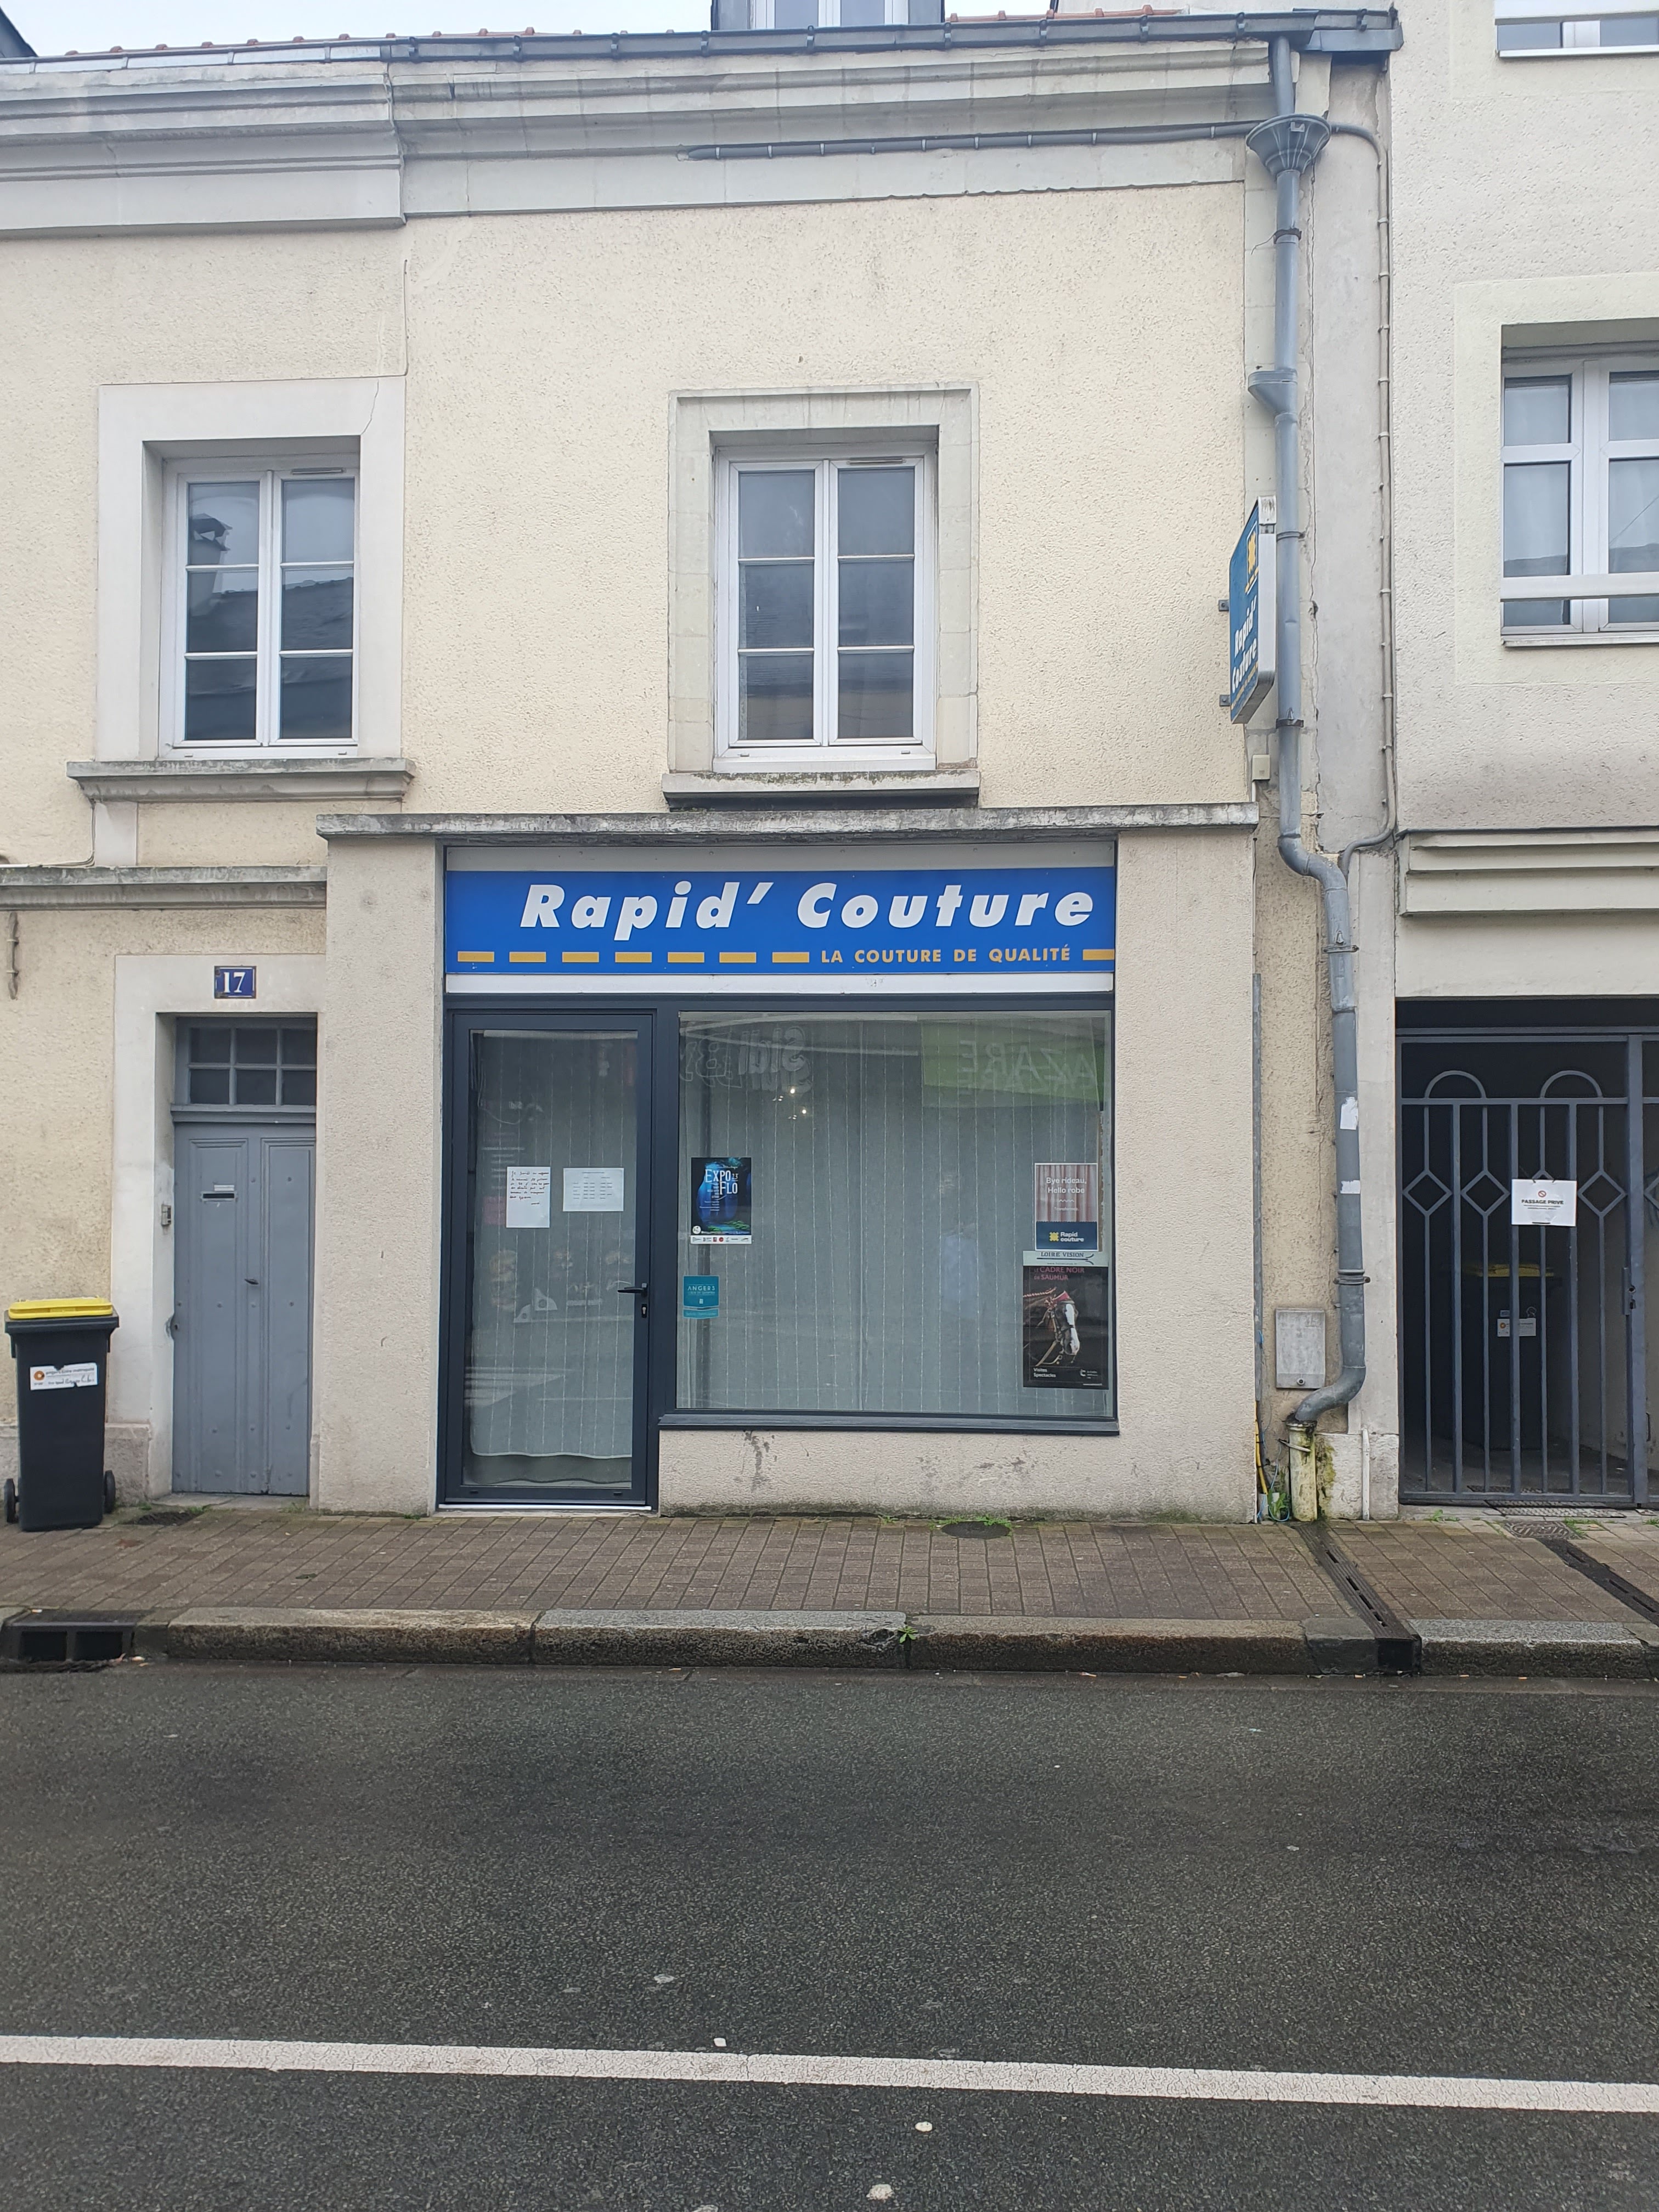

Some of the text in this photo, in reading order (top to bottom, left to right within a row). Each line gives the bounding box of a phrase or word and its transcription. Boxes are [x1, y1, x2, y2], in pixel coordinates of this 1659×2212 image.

[1234, 594, 1257, 658] Rapid'
[1232, 637, 1257, 694] Couture
[520, 881, 1094, 941] Rapid' Couture
[821, 944, 1070, 963] LA COUTURE DE QUALITÉ
[223, 972, 246, 994] 17
[719, 1181, 738, 1195] FLO
[1046, 1177, 1060, 1185] Bye
